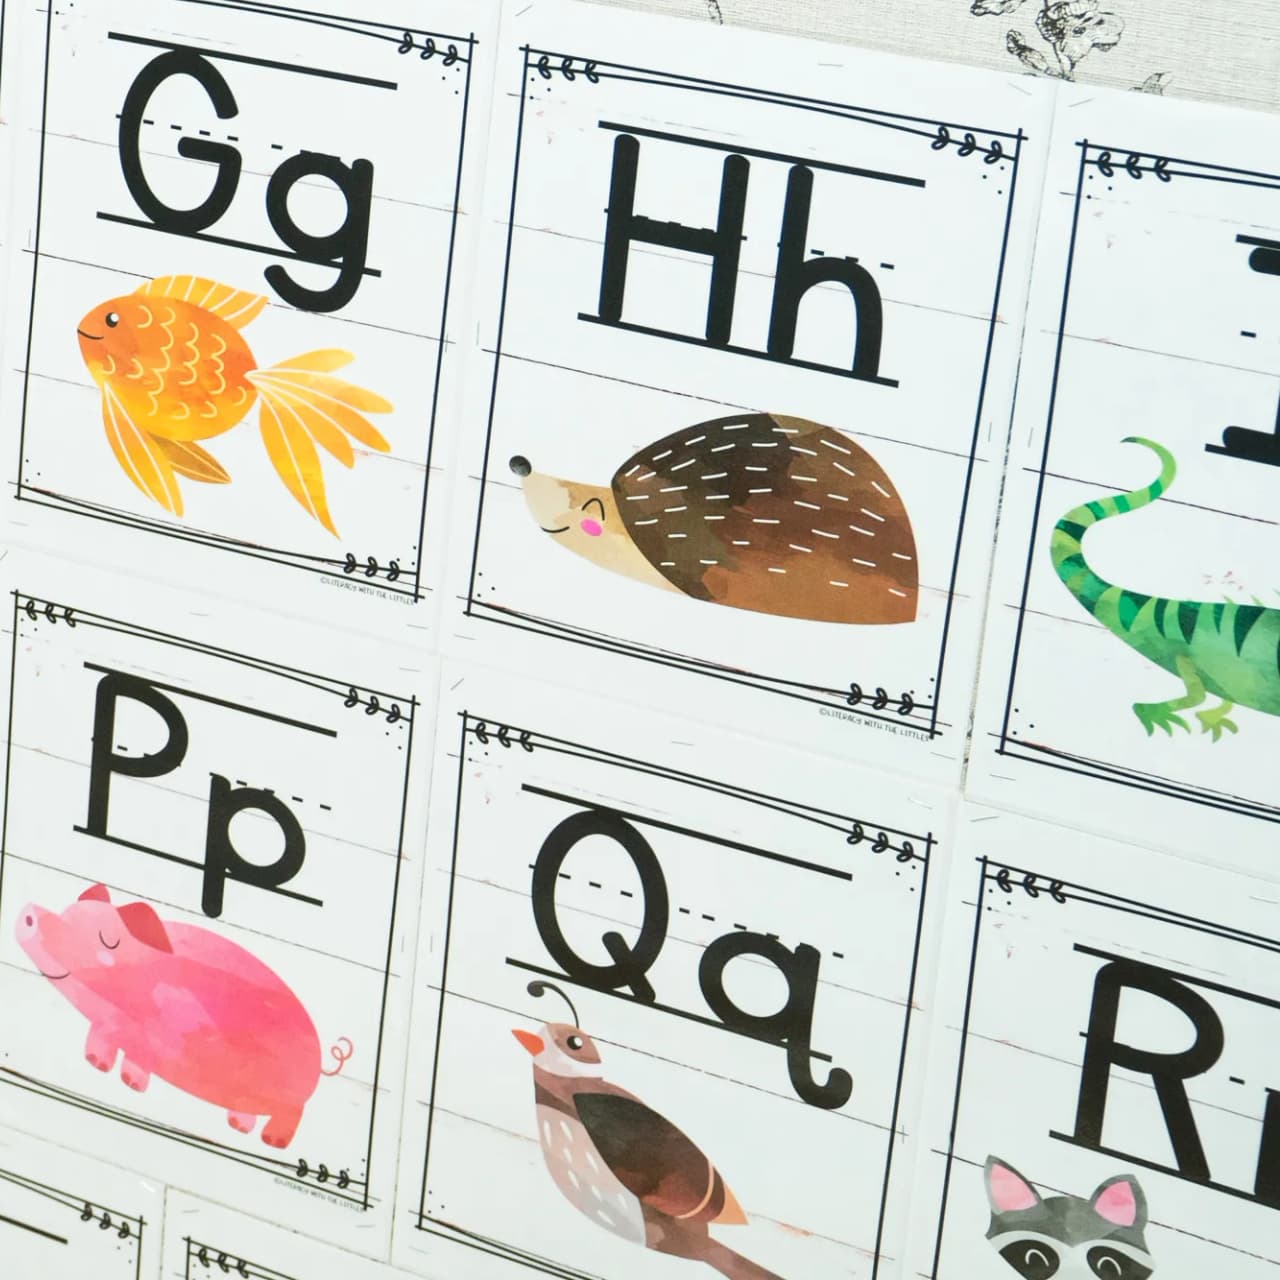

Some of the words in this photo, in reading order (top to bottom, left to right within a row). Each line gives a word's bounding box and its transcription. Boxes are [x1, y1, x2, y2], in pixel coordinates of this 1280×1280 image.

[119, 50, 374, 312] Gg
[597, 134, 884, 377] Hh
[88, 673, 306, 918] Pp
[531, 809, 853, 1110] Qq
